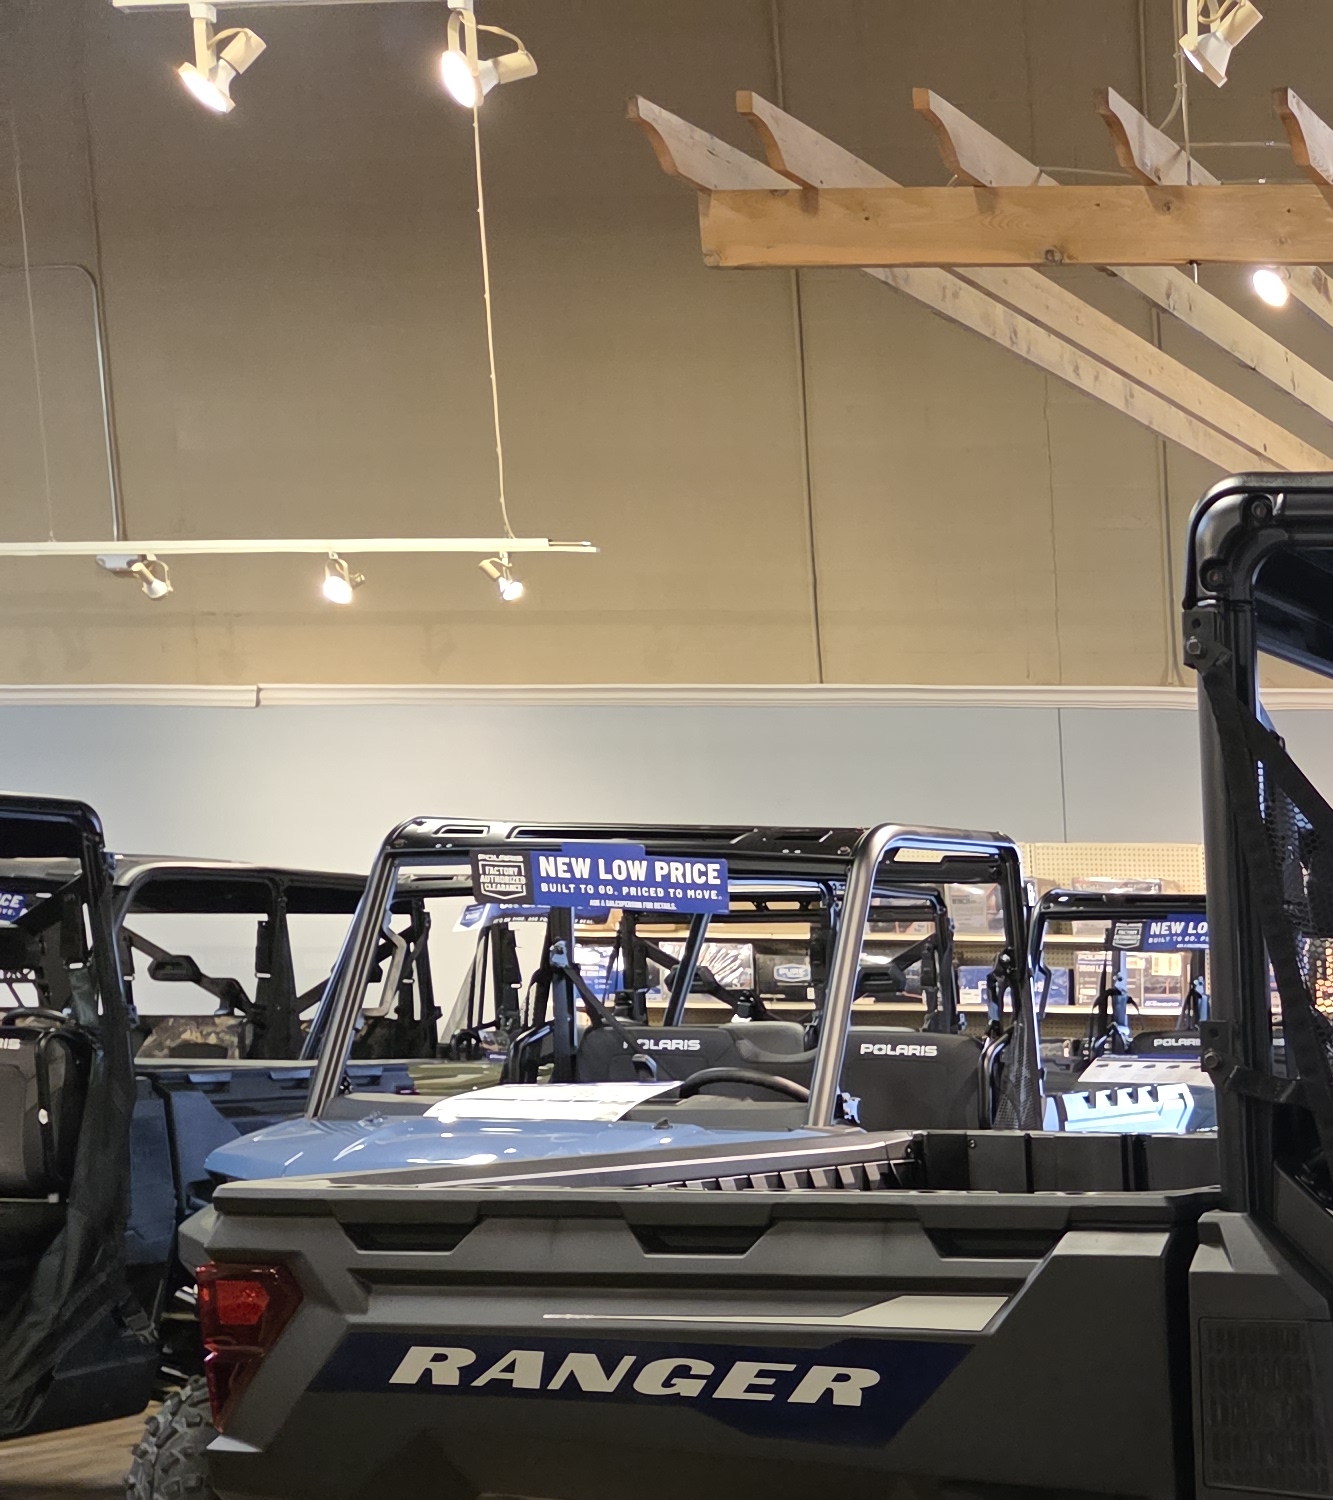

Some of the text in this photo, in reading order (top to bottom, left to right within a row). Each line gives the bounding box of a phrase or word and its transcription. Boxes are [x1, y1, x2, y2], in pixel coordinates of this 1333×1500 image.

[485, 866, 518, 874] FACTORY
[539, 856, 721, 884] NEW LOW PRICE
[480, 875, 526, 884] AUTHORIZED
[541, 883, 575, 893] BUILT
[580, 885, 594, 893] TO
[622, 887, 664, 897] PRICED
[668, 889, 683, 897] TO
[1150, 922, 1185, 934] NEW
[1187, 922, 1209, 934] LO
[1154, 1038, 1200, 1047] POLARI
[860, 1044, 938, 1056] POLARIS
[388, 1346, 881, 1406] RANGER
